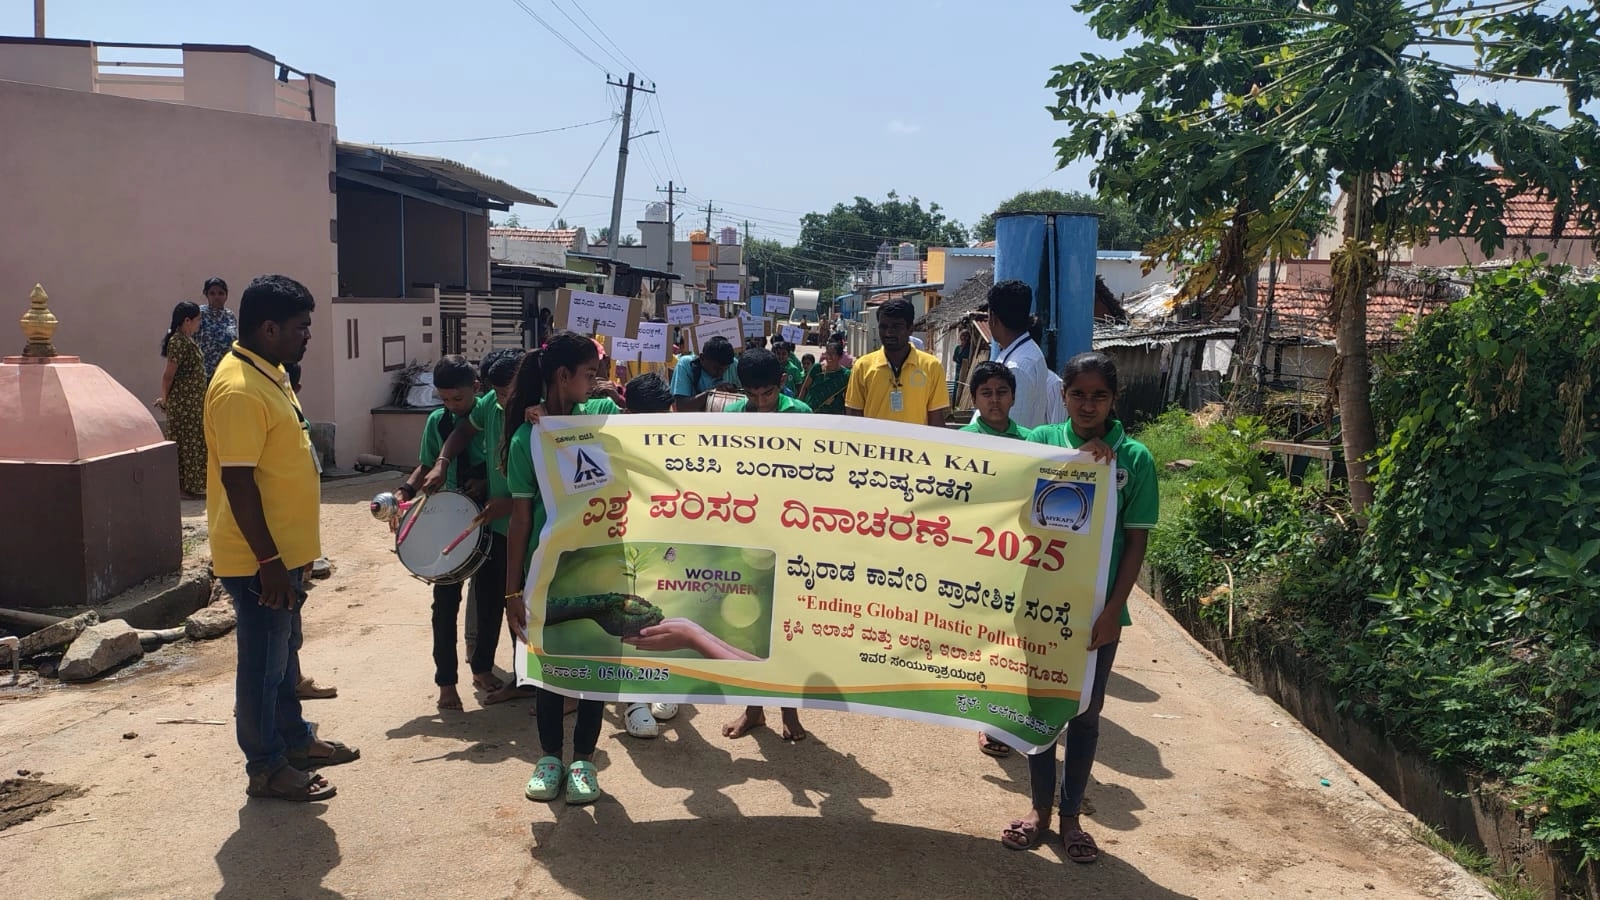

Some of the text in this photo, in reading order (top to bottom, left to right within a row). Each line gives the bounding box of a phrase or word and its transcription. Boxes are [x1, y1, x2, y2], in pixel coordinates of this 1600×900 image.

[643, 433, 998, 476] ITC MISSION SUNEHRA KAL
[665, 456, 973, 502] ಐಟಿಸಿ ಬಂಗಾರದ ಭವಿಷ್ಯದೆಡೆಗೆ
[583, 489, 632, 539] ವಿಶ್ವ
[649, 488, 760, 524] ಪರಿಸರ
[685, 568, 741, 581] WORLD
[786, 555, 1073, 640] ಮೈರಾಡ ಕಾವೇರಿ ಪ್ರಾದೇಶಿಕ ಸಂಸ್ಥೆ
[867, 603, 919, 624] Global
[923, 611, 973, 636] Plastic
[542, 663, 669, 681] ದಿನಾಂಕ: 05.06.2025
[783, 618, 1069, 686] ಕೃಷಿ ಇಲಾಖೆ ಮತ್ತು ಅರಣ್ಯ ಇಲಾಖೆ ನಂಜನಗೂಡು
[859, 652, 988, 690] ಇವರ ಸಂಯುಕ್ತಾಶ್ರಯದಲ್ಲಿ
